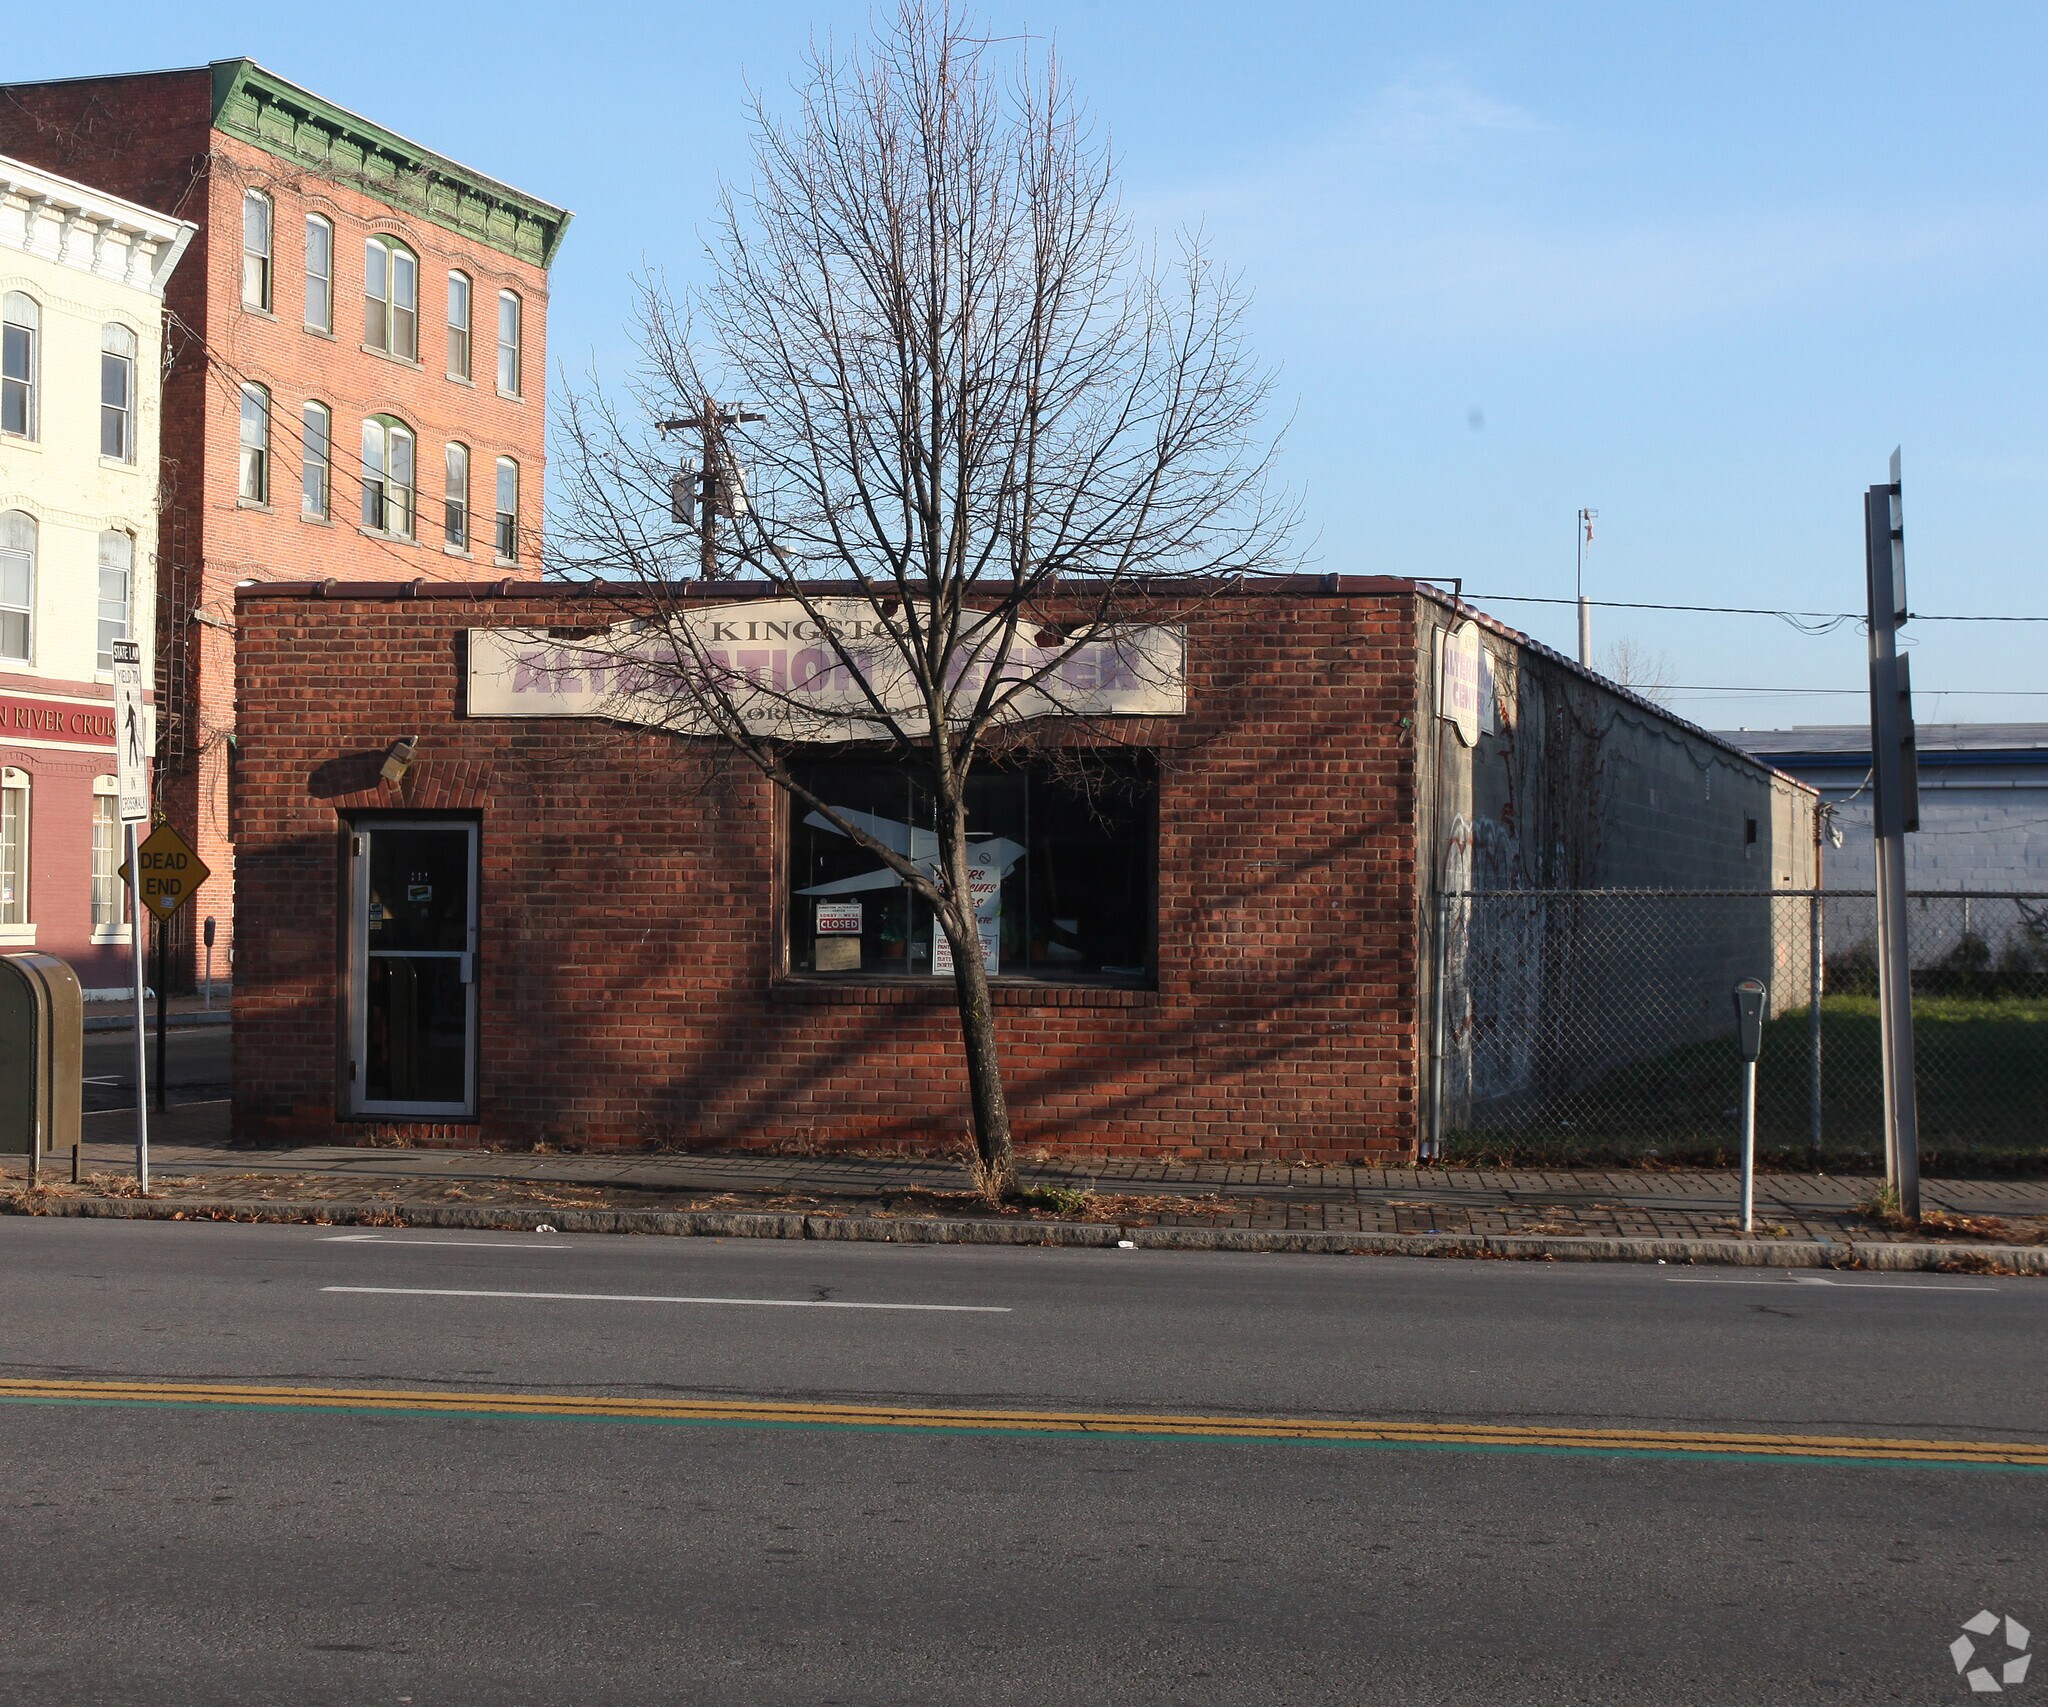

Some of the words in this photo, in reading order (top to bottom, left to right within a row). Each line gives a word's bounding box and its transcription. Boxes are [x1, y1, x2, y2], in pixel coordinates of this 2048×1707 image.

[14, 706, 65, 732] RIVER
[71, 712, 116, 738] CRUIS
[140, 852, 188, 870] DEAD
[146, 878, 182, 895] END
[820, 920, 858, 929] CLOSED
